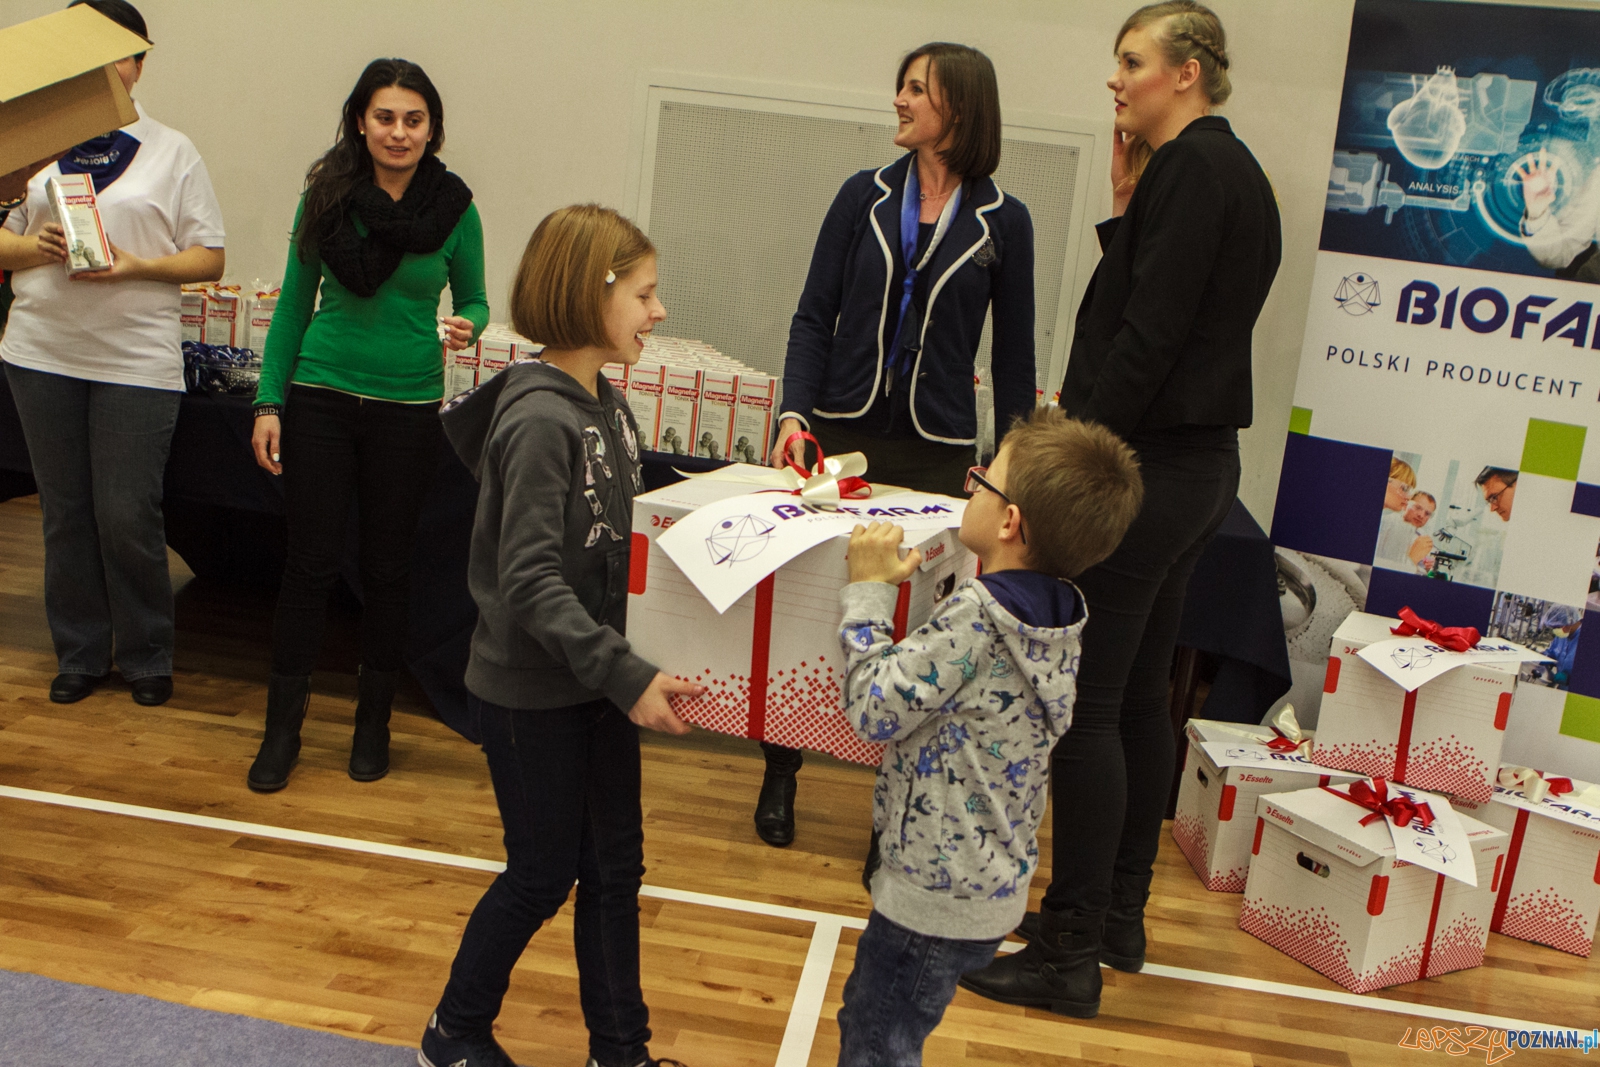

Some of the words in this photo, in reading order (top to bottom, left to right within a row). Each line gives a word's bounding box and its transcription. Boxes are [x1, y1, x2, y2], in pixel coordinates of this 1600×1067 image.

[1408, 181, 1460, 195] ANALYSIS
[1396, 279, 1600, 349] BIOFA
[1326, 345, 1410, 373] POLSKI
[1426, 360, 1582, 398] PRODUCENT
[929, 542, 946, 559] Esselte
[1245, 774, 1273, 784] Esselte
[1450, 796, 1478, 810] Esselte
[1271, 808, 1294, 826] Esselte
